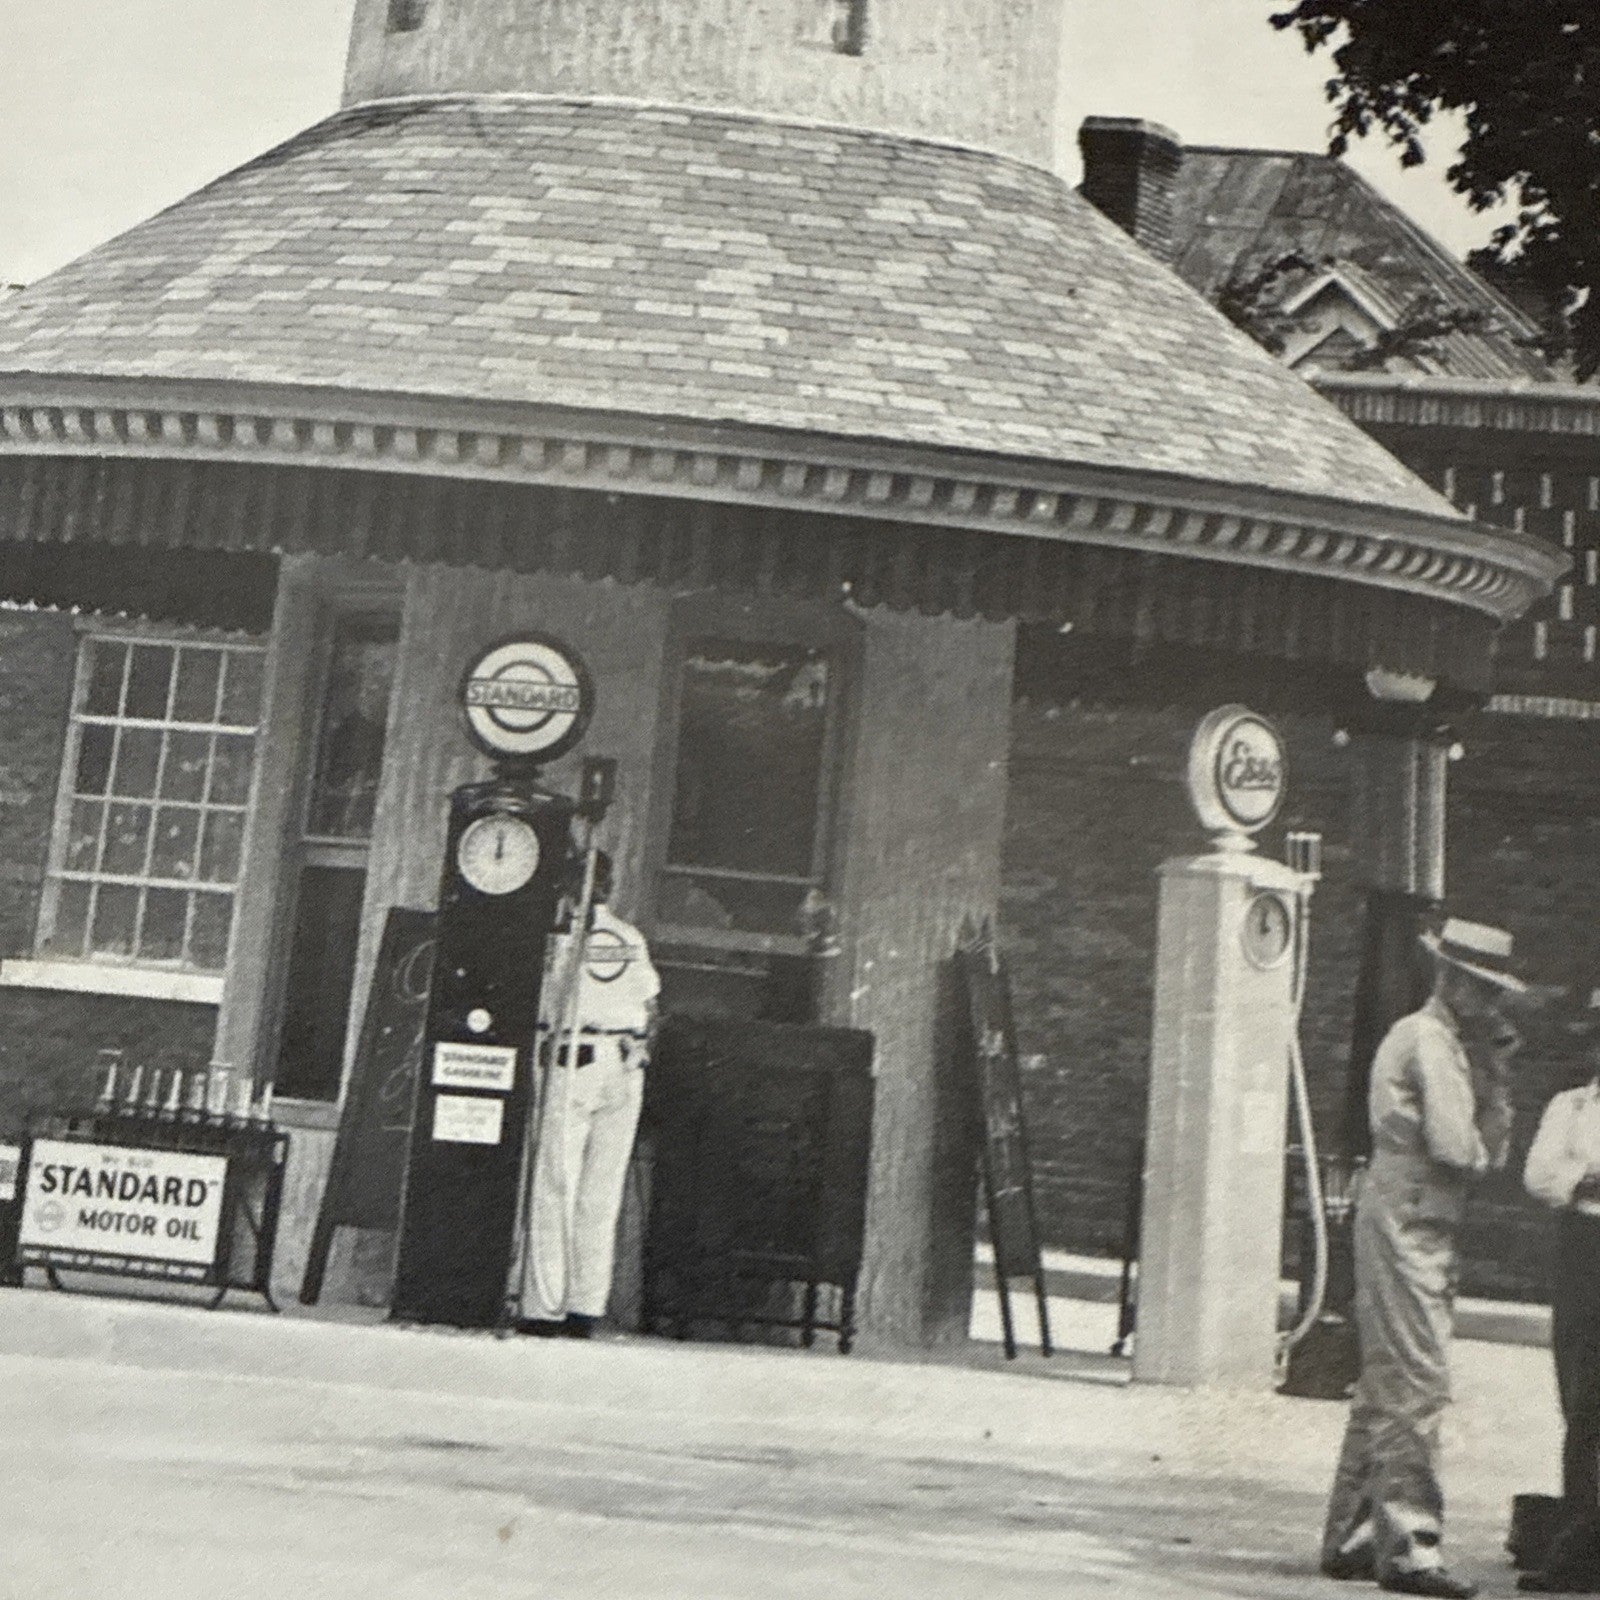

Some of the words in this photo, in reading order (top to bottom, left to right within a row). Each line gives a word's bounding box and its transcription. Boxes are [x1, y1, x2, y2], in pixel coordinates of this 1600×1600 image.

[466, 681, 580, 711] STANDARD
[1224, 741, 1279, 790] Esso
[78, 1208, 157, 1236] MOTOR
[166, 1217, 202, 1241] OIL
